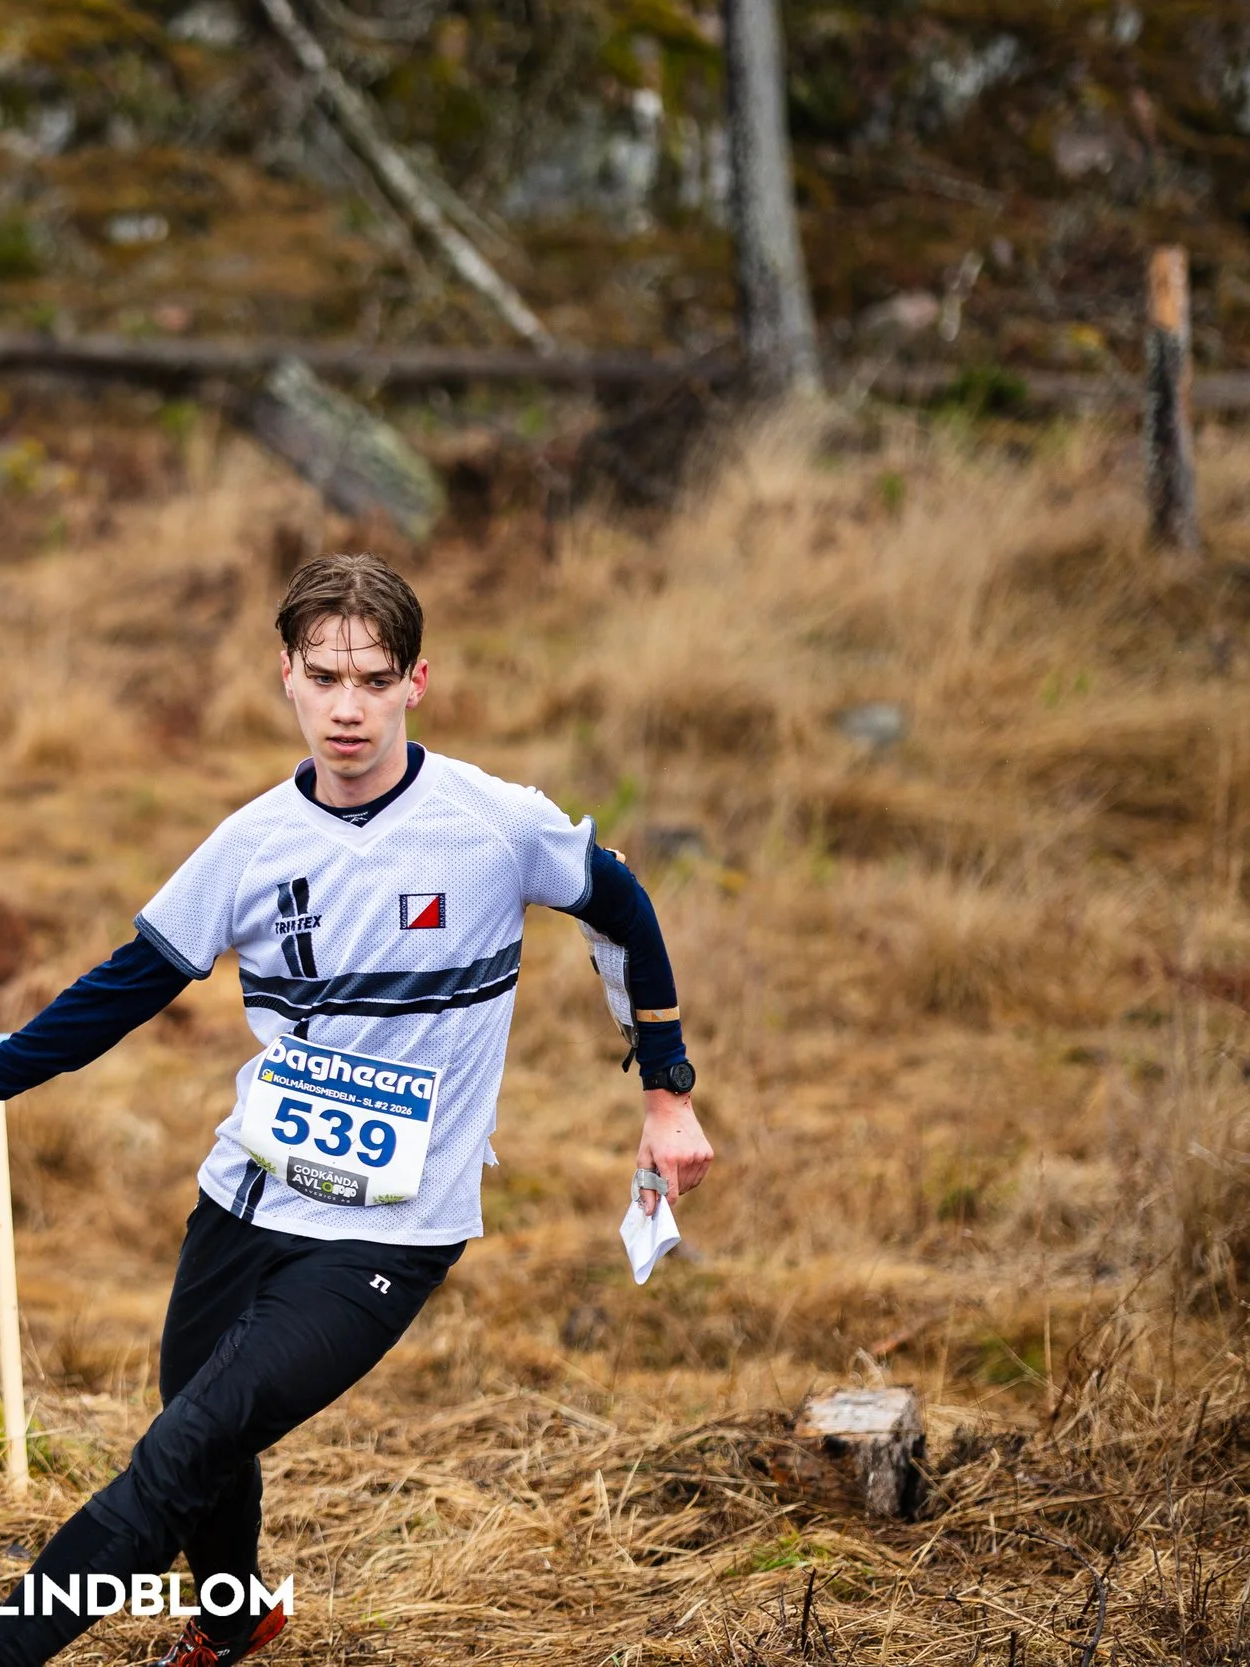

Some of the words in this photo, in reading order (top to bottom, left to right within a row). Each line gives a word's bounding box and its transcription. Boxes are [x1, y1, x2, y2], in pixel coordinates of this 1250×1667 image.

[265, 1039, 434, 1100] bagheera
[273, 1074, 357, 1102] KOLMÅRDSMEDELN
[363, 1097, 373, 1107] SL
[375, 1101, 388, 1111] #2
[390, 1104, 412, 1115] 2026
[272, 1097, 396, 1167] 539
[294, 1165, 358, 1189] GODKÄNDA
